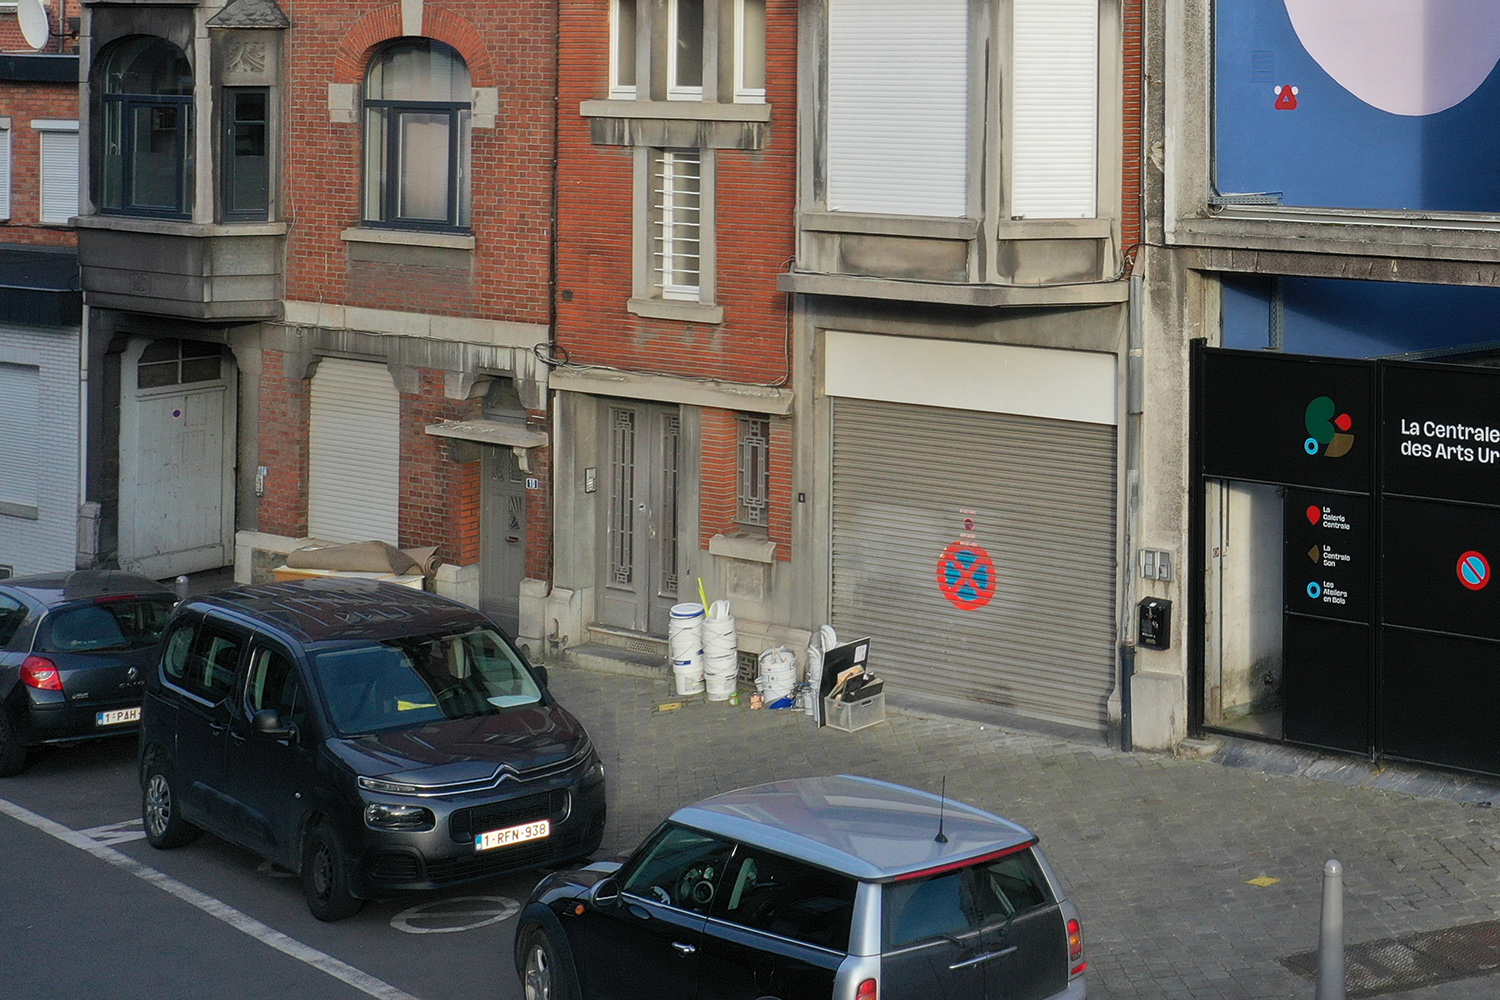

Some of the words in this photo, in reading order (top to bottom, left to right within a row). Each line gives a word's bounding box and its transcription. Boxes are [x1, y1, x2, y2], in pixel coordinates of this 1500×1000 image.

[1401, 418, 1420, 436] La
[1423, 421, 1500, 443] Centrale
[1400, 440, 1432, 458] des
[1435, 443, 1474, 462] Arts
[1323, 544, 1331, 552] La
[484, 823, 546, 846] 1-RFN-938
